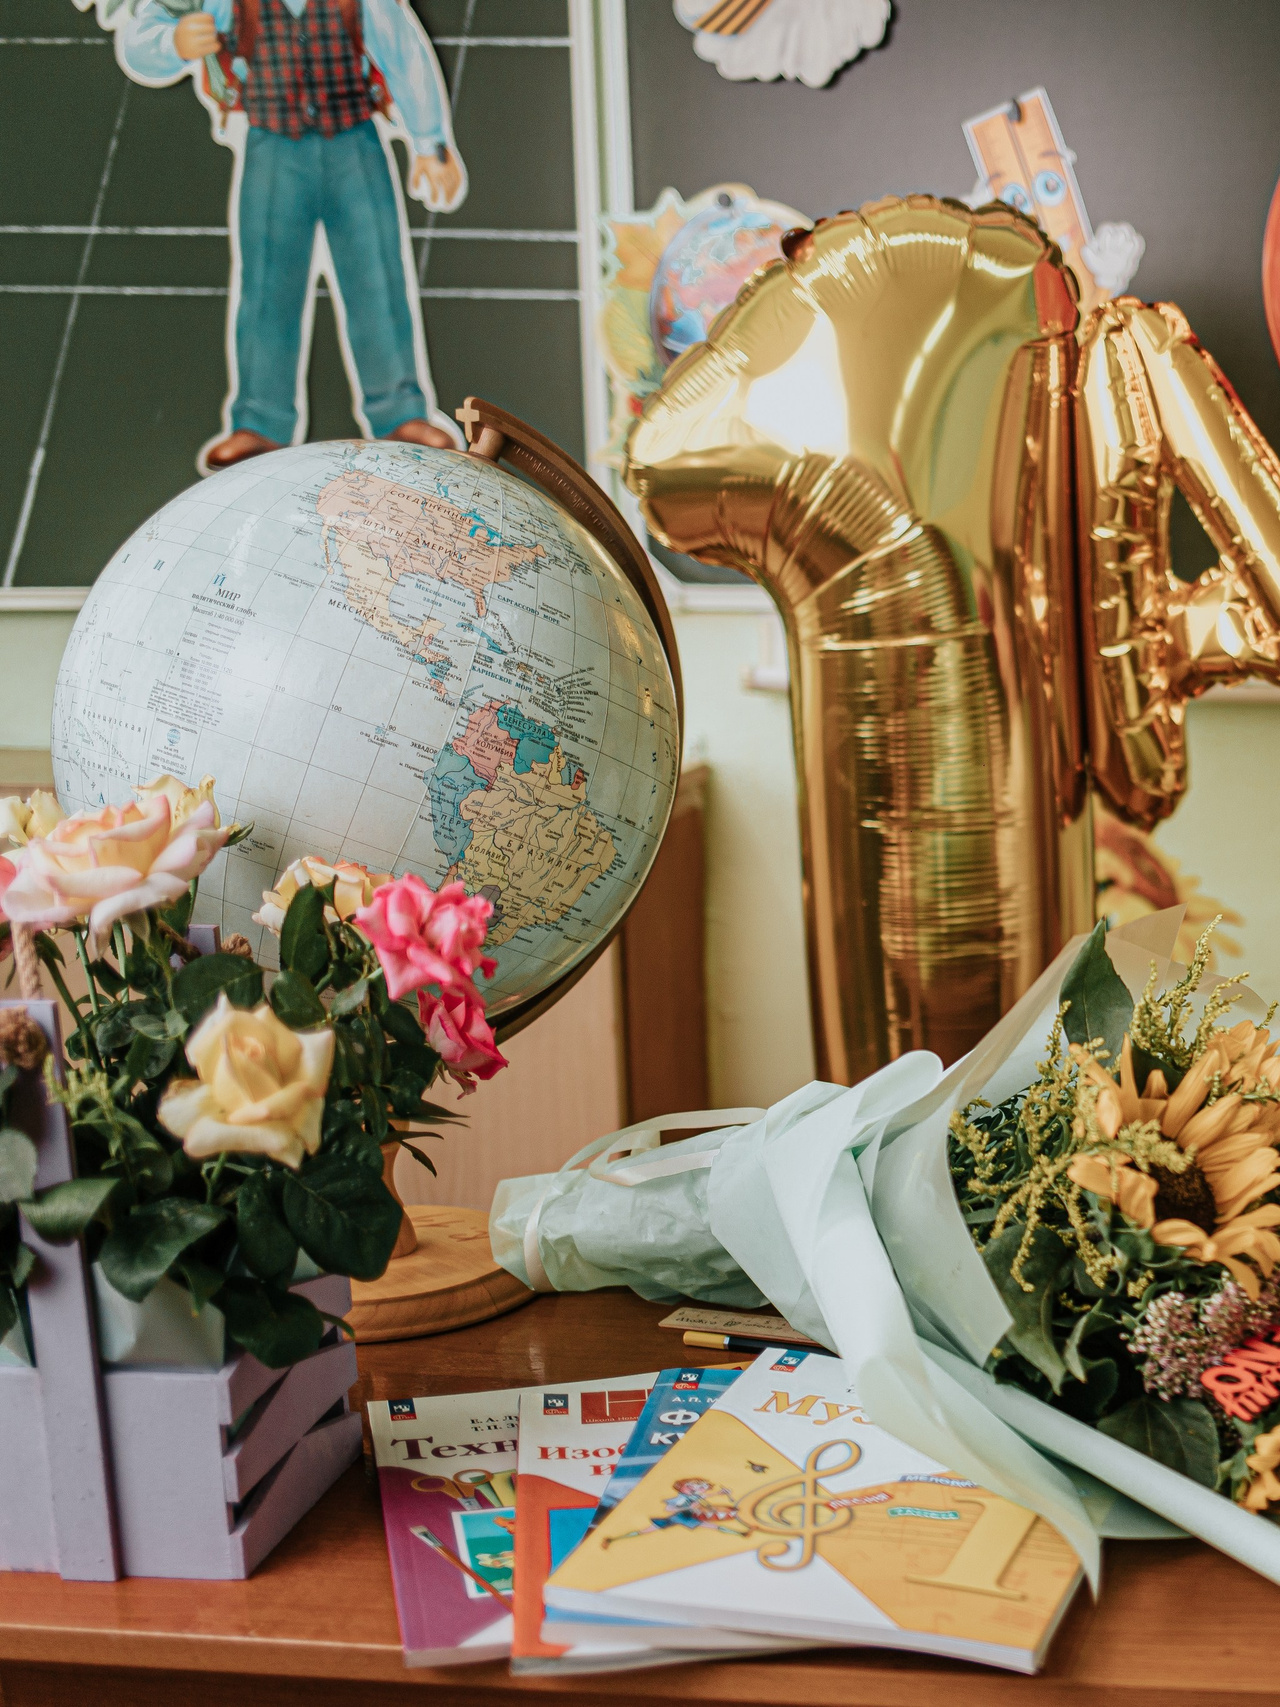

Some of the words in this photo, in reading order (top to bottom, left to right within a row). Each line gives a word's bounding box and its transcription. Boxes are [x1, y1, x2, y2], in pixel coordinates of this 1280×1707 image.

[363, 519, 404, 538] ШТАТЫ
[413, 537, 468, 561] АМЕРИКИ
[215, 588, 241, 601] МИР
[191, 593, 236, 610] политический
[235, 606, 257, 618] глобус
[328, 599, 374, 621] МЕКСИКА
[515, 680, 534, 693] МОРЕ
[503, 714, 546, 737] ВЕНЕСУЭЛА
[410, 742, 438, 755] ЭКВАДОР
[476, 740, 514, 758] КОЛУМБИЯ
[441, 814, 468, 829] ПЕРУ
[469, 845, 506, 862] БОЛИВИЯ
[507, 839, 581, 874] БРАЗИЛИЯ
[904, 1494, 1040, 1601] 1
